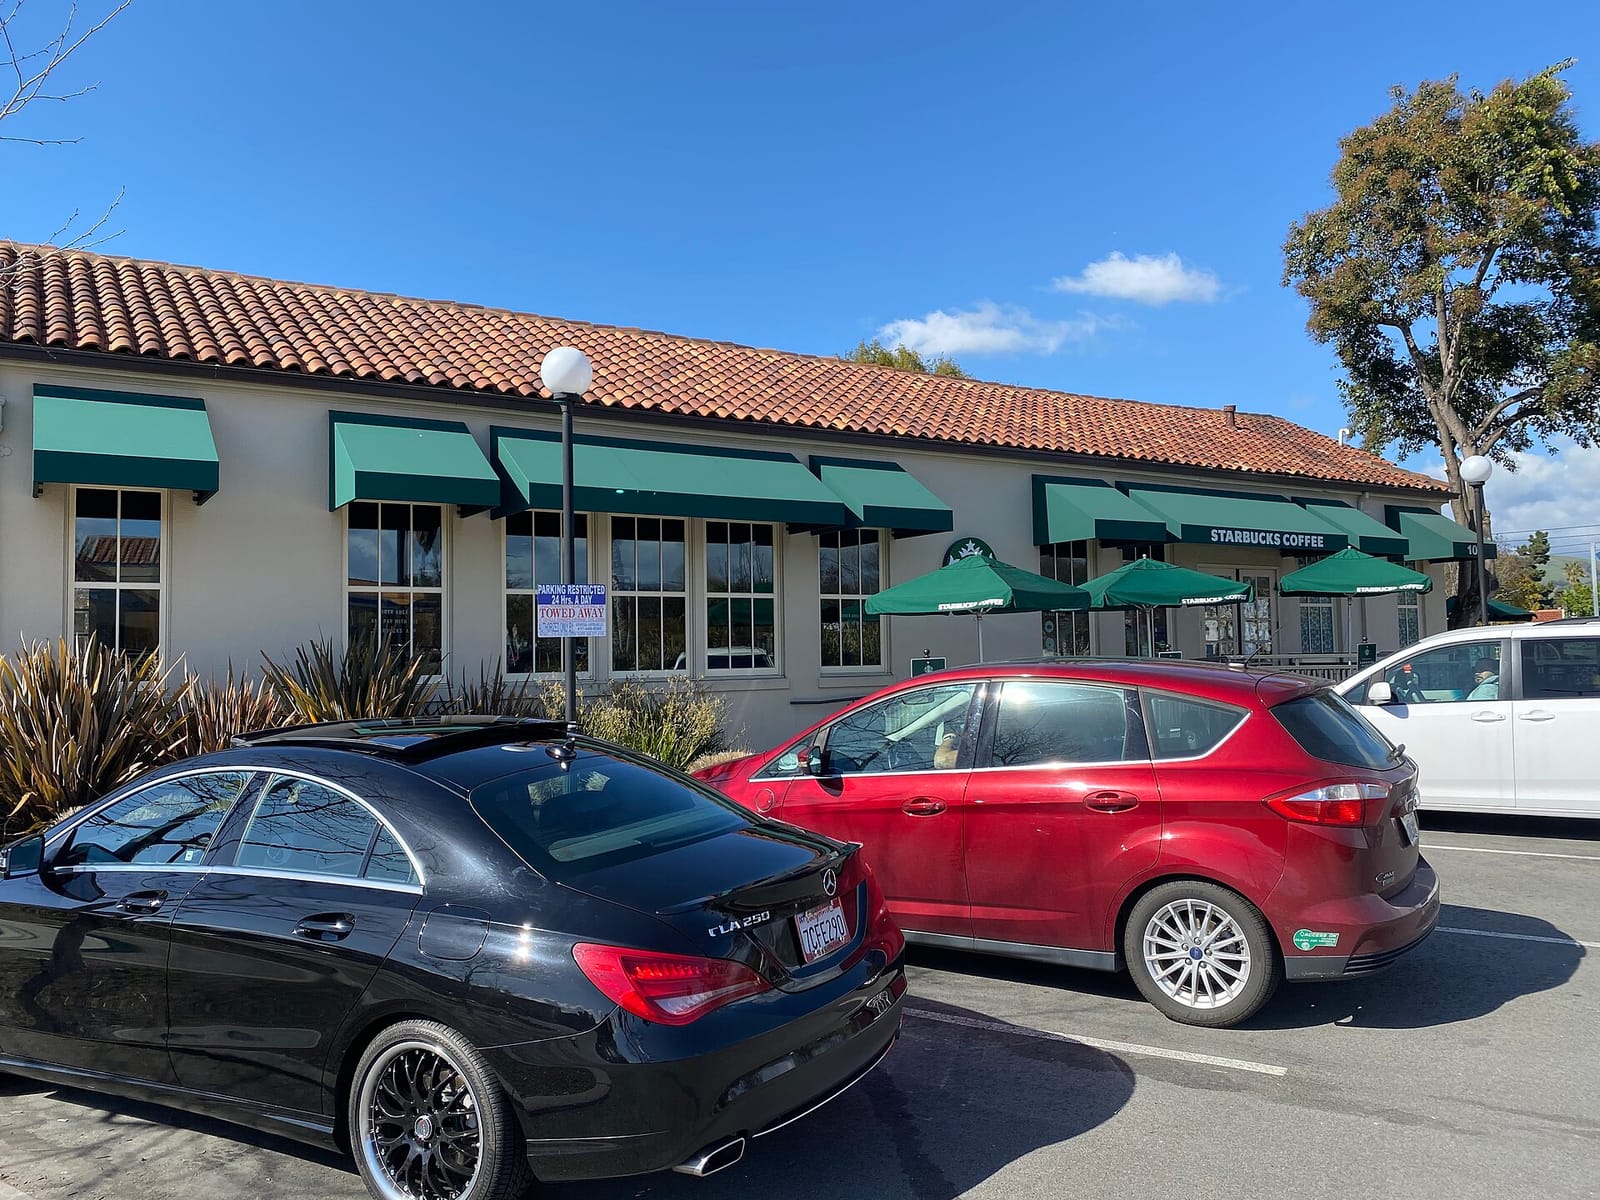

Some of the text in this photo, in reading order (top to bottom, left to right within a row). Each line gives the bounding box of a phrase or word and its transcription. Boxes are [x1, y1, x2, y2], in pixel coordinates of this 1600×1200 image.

[1211, 529, 1324, 548] STARBUCKS COFFEE
[538, 585, 605, 595] PARKING RESTRICTED
[551, 595, 592, 604] 24 Hrs. A DAY
[540, 608, 605, 618] TOWED AWAY
[708, 910, 770, 937] CLA 250
[802, 914, 845, 954] 7CFE290
